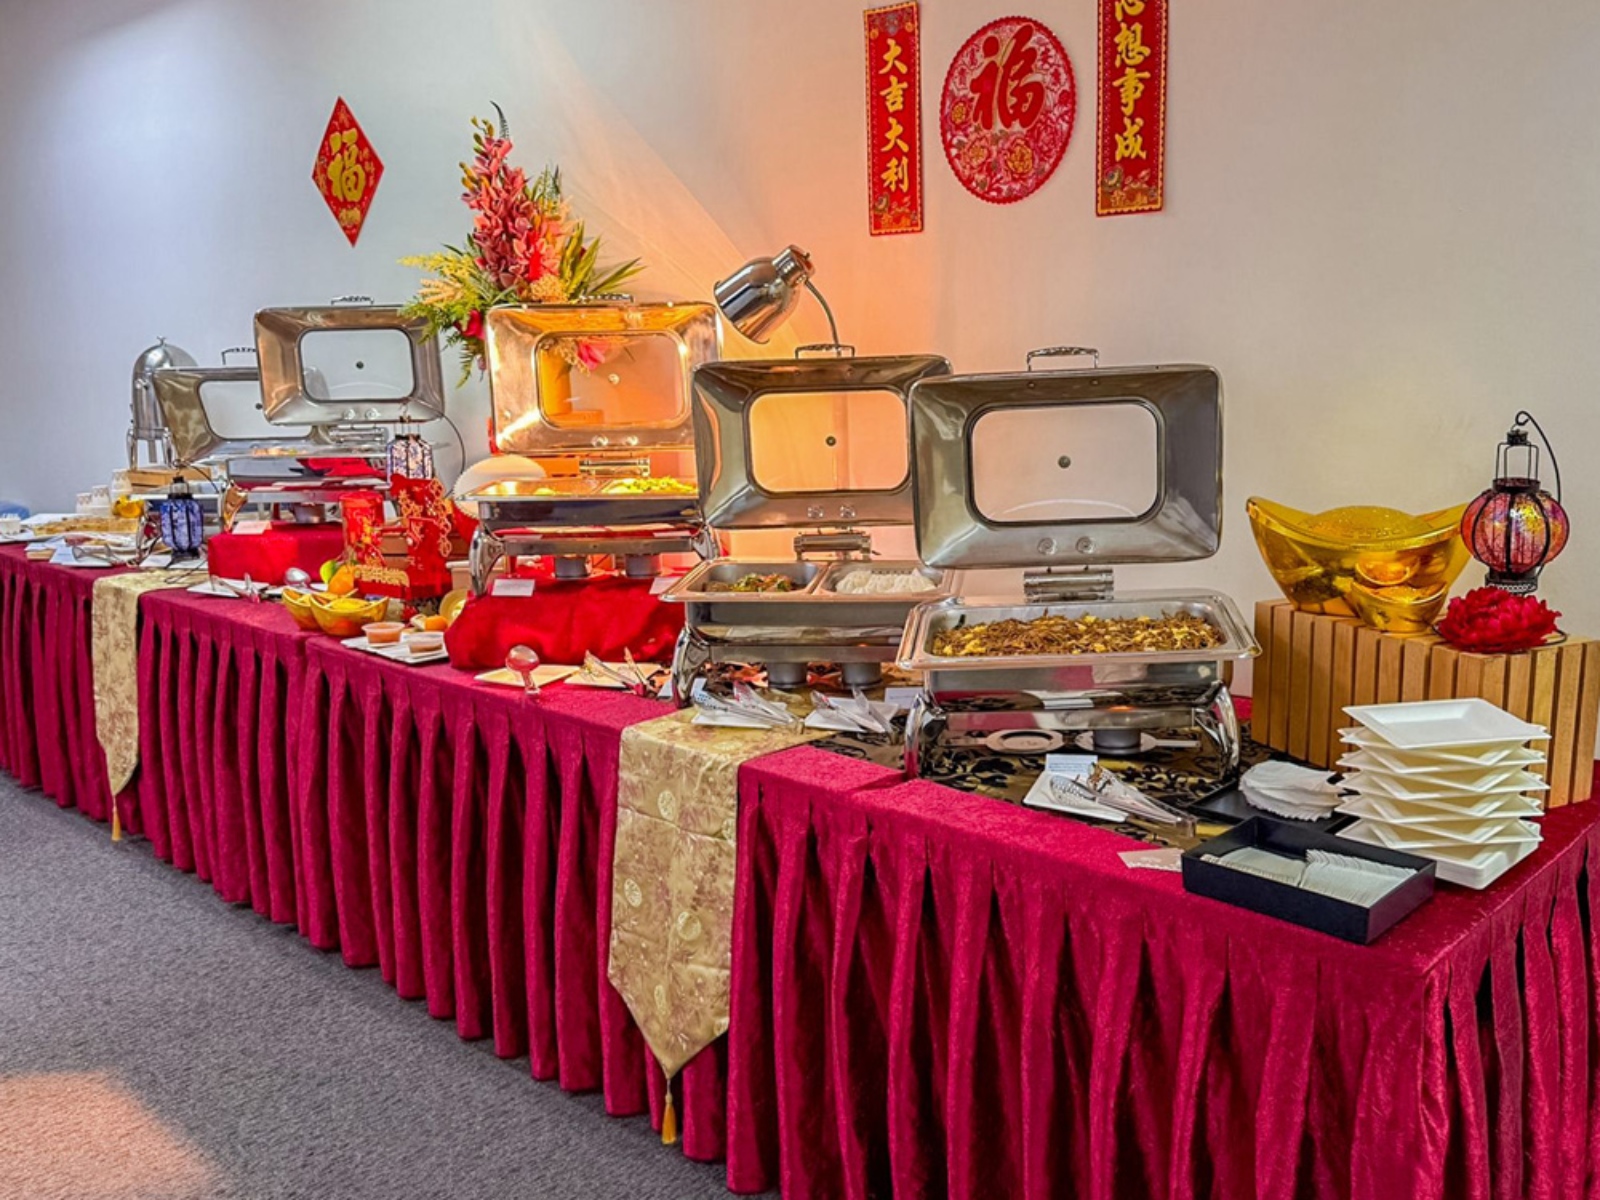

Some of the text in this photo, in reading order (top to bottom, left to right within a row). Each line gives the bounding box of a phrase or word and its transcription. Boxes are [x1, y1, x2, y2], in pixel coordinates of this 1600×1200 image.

[879, 38, 909, 193] 大吉大利
[969, 23, 1045, 130] 福
[327, 128, 366, 201] 福
